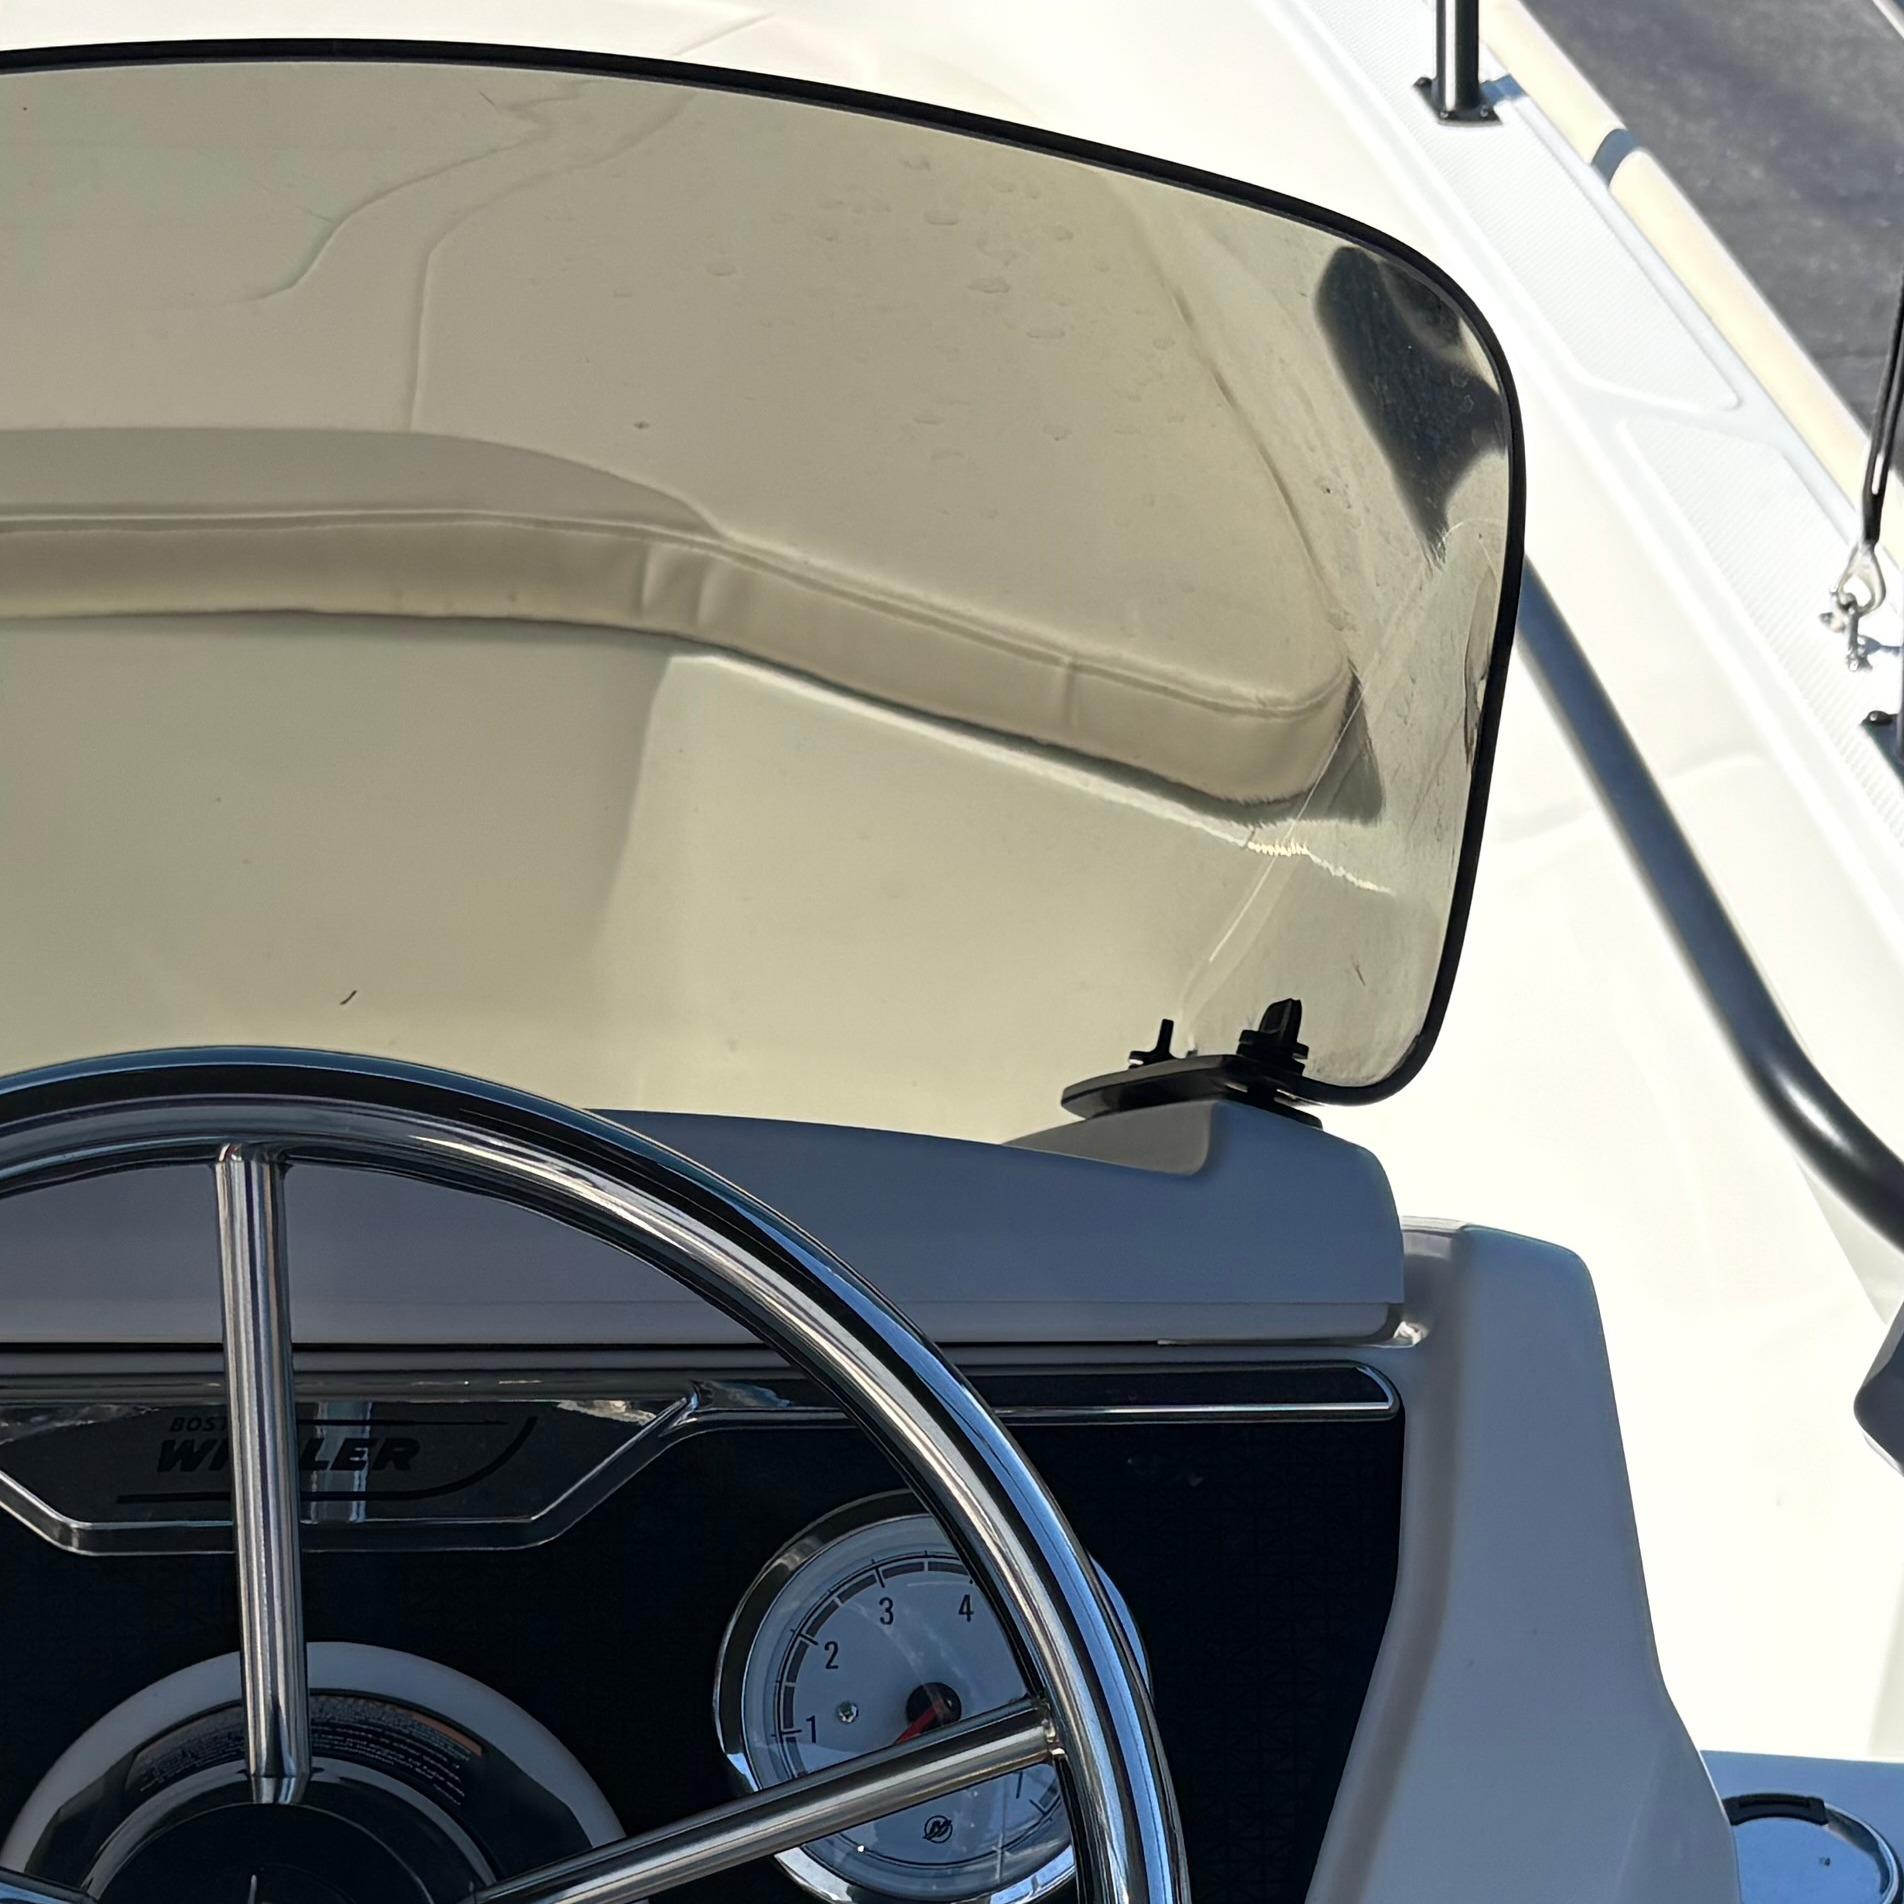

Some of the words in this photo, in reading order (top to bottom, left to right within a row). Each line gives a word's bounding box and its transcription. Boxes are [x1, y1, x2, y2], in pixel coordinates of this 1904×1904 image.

[157, 1437, 421, 1473] WLER
[879, 1597, 894, 1626] 3
[958, 1594, 974, 1622] 4
[825, 1640, 839, 1669] 2
[805, 1715, 817, 1743] 1
